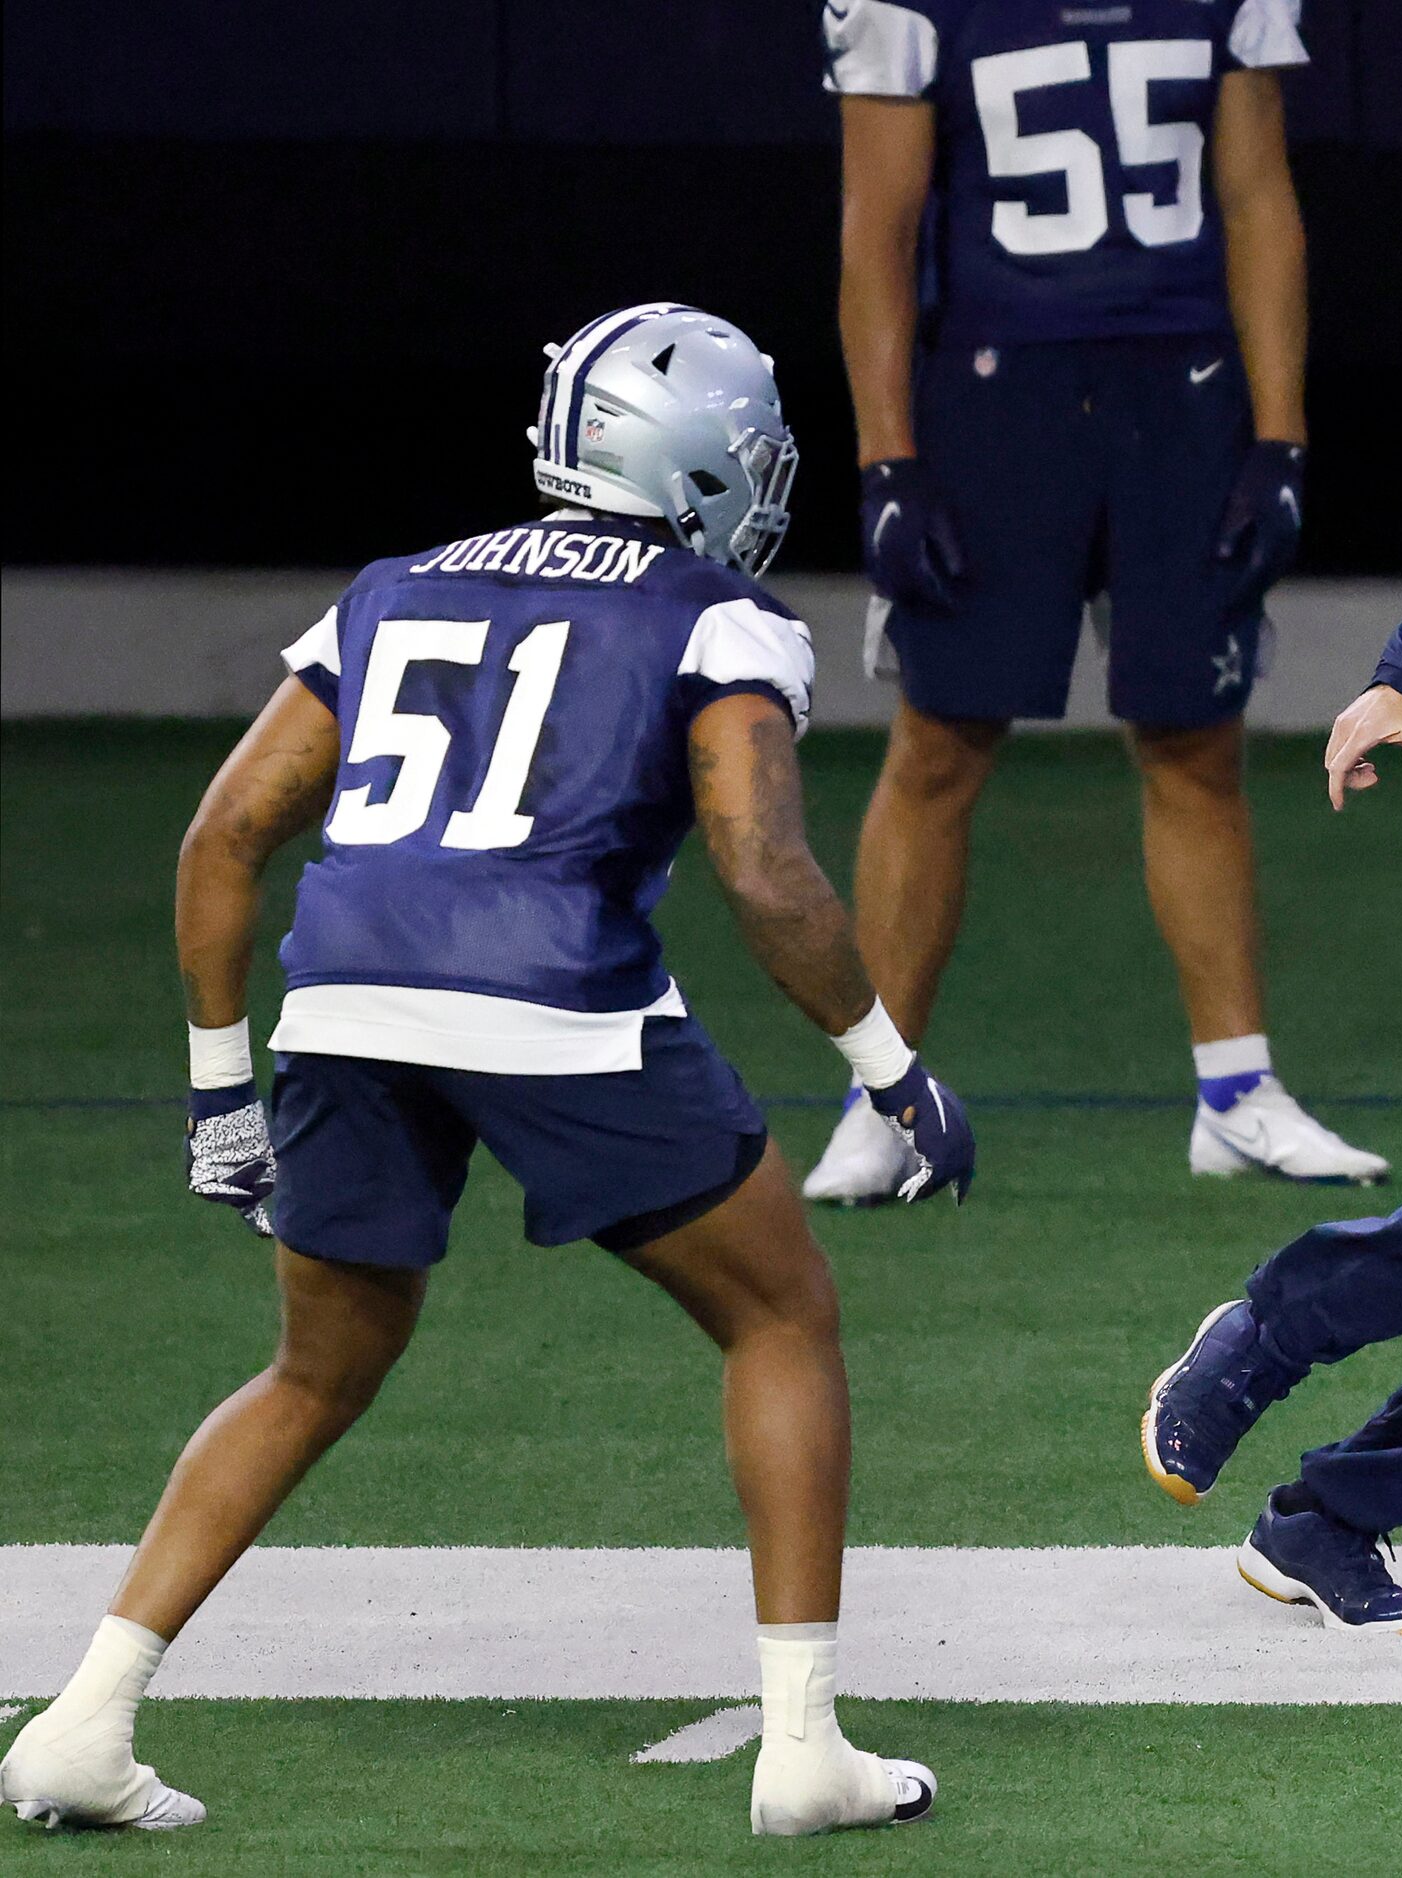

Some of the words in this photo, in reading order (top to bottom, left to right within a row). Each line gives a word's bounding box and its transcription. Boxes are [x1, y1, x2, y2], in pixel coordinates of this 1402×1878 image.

[971, 40, 1212, 255] 55
[409, 527, 666, 584] JOHNSON
[325, 619, 571, 851] 51
